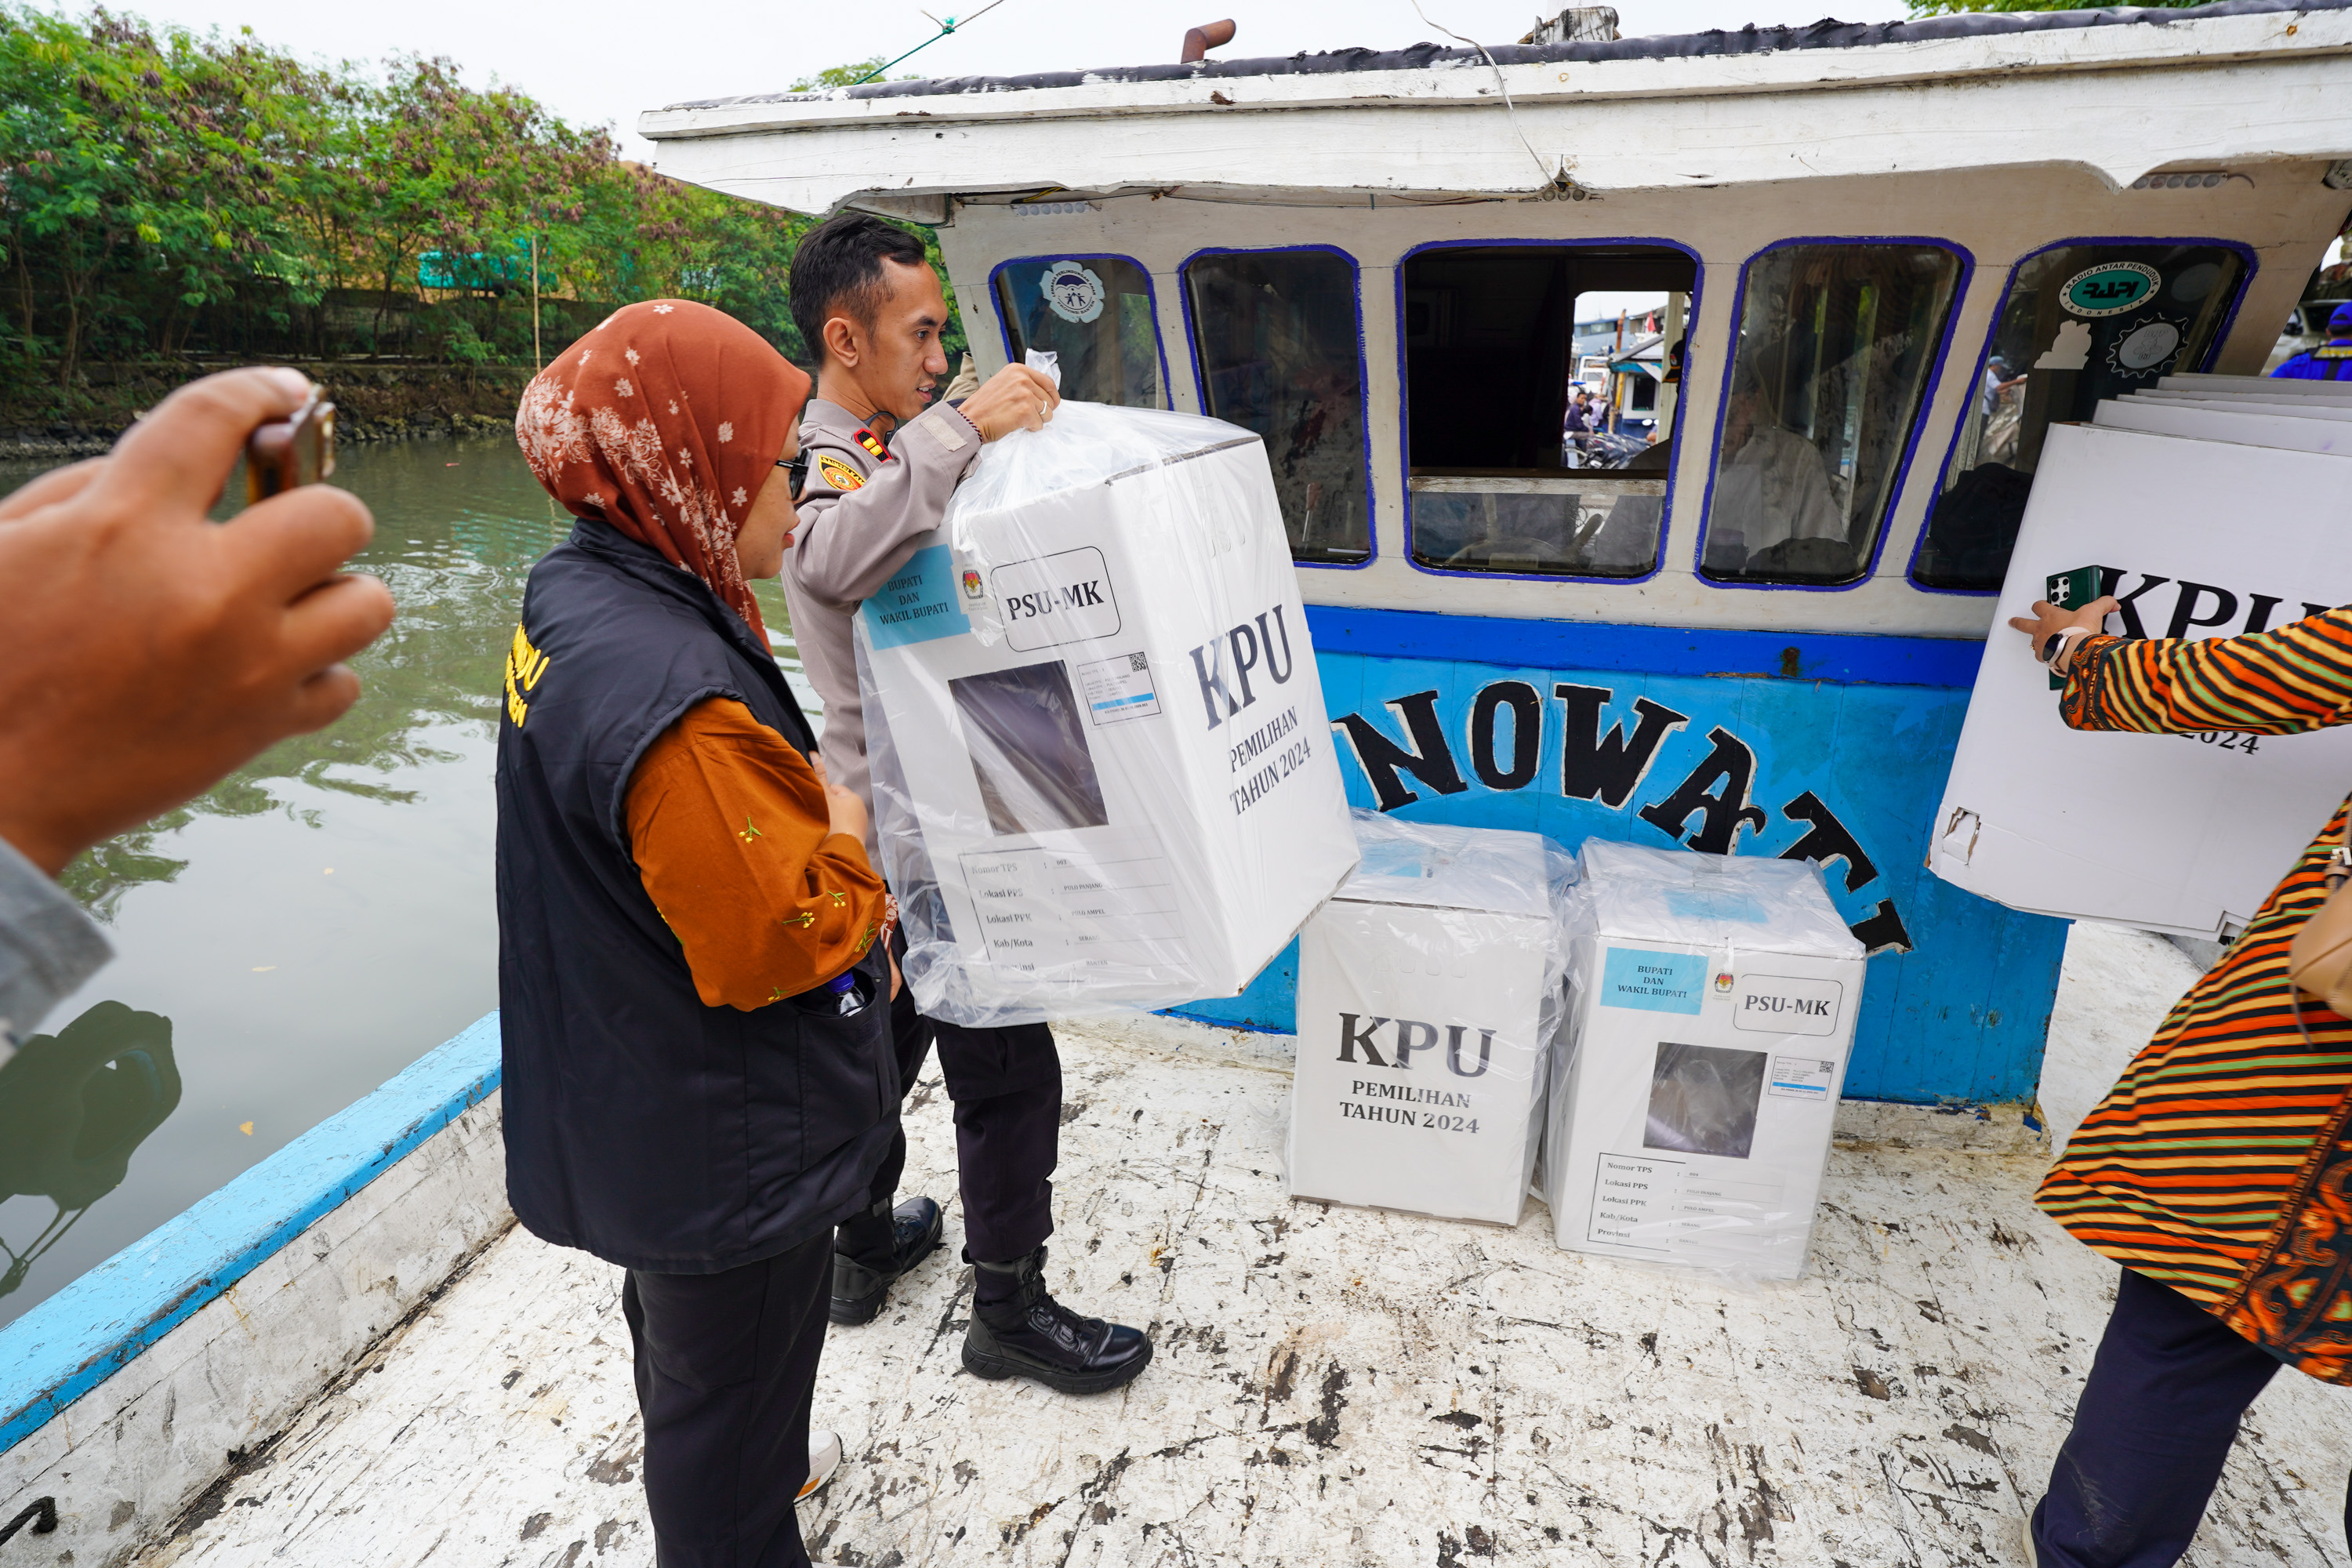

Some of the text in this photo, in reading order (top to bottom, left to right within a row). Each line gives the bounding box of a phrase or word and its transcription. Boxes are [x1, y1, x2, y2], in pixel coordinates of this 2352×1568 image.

[2066, 263, 2159, 289] RADIO ANTAR PENDUDUK
[2064, 299, 2144, 315] INDONESIA
[887, 575, 924, 592] BUPATI
[898, 592, 920, 605] DAN
[1006, 580, 1105, 620] PSU-MK
[880, 602, 949, 625] WAKIL BUPATI
[1189, 604, 1292, 731] KPU
[1228, 706, 1299, 773] PEMILIHAN
[2179, 731, 2260, 755] 024
[1229, 735, 1311, 815] TAHUN 2024
[971, 863, 1018, 875] Nomor TPS
[979, 888, 1024, 898] Lokasi PPS
[986, 913, 1033, 924] Lokasi PPK
[993, 938, 1033, 949] Kab/Kota
[1637, 965, 1673, 975] BUPATI
[1643, 976, 1664, 985] DAN
[1617, 985, 1687, 998] WAKIL BUPATI
[1744, 994, 1831, 1016] PSU-MK
[1335, 1012, 1497, 1078] KPU
[1352, 1080, 1472, 1109] PEMILIHAN
[1339, 1102, 1480, 1134] TAHUN 2024
[1607, 1162, 1635, 1171] Nomor
[1605, 1179, 1632, 1188] Lokasi
[1602, 1196, 1628, 1204] Lokasi
[1599, 1212, 1638, 1222] Kab/Kota
[1597, 1228, 1631, 1238] Provinsi
